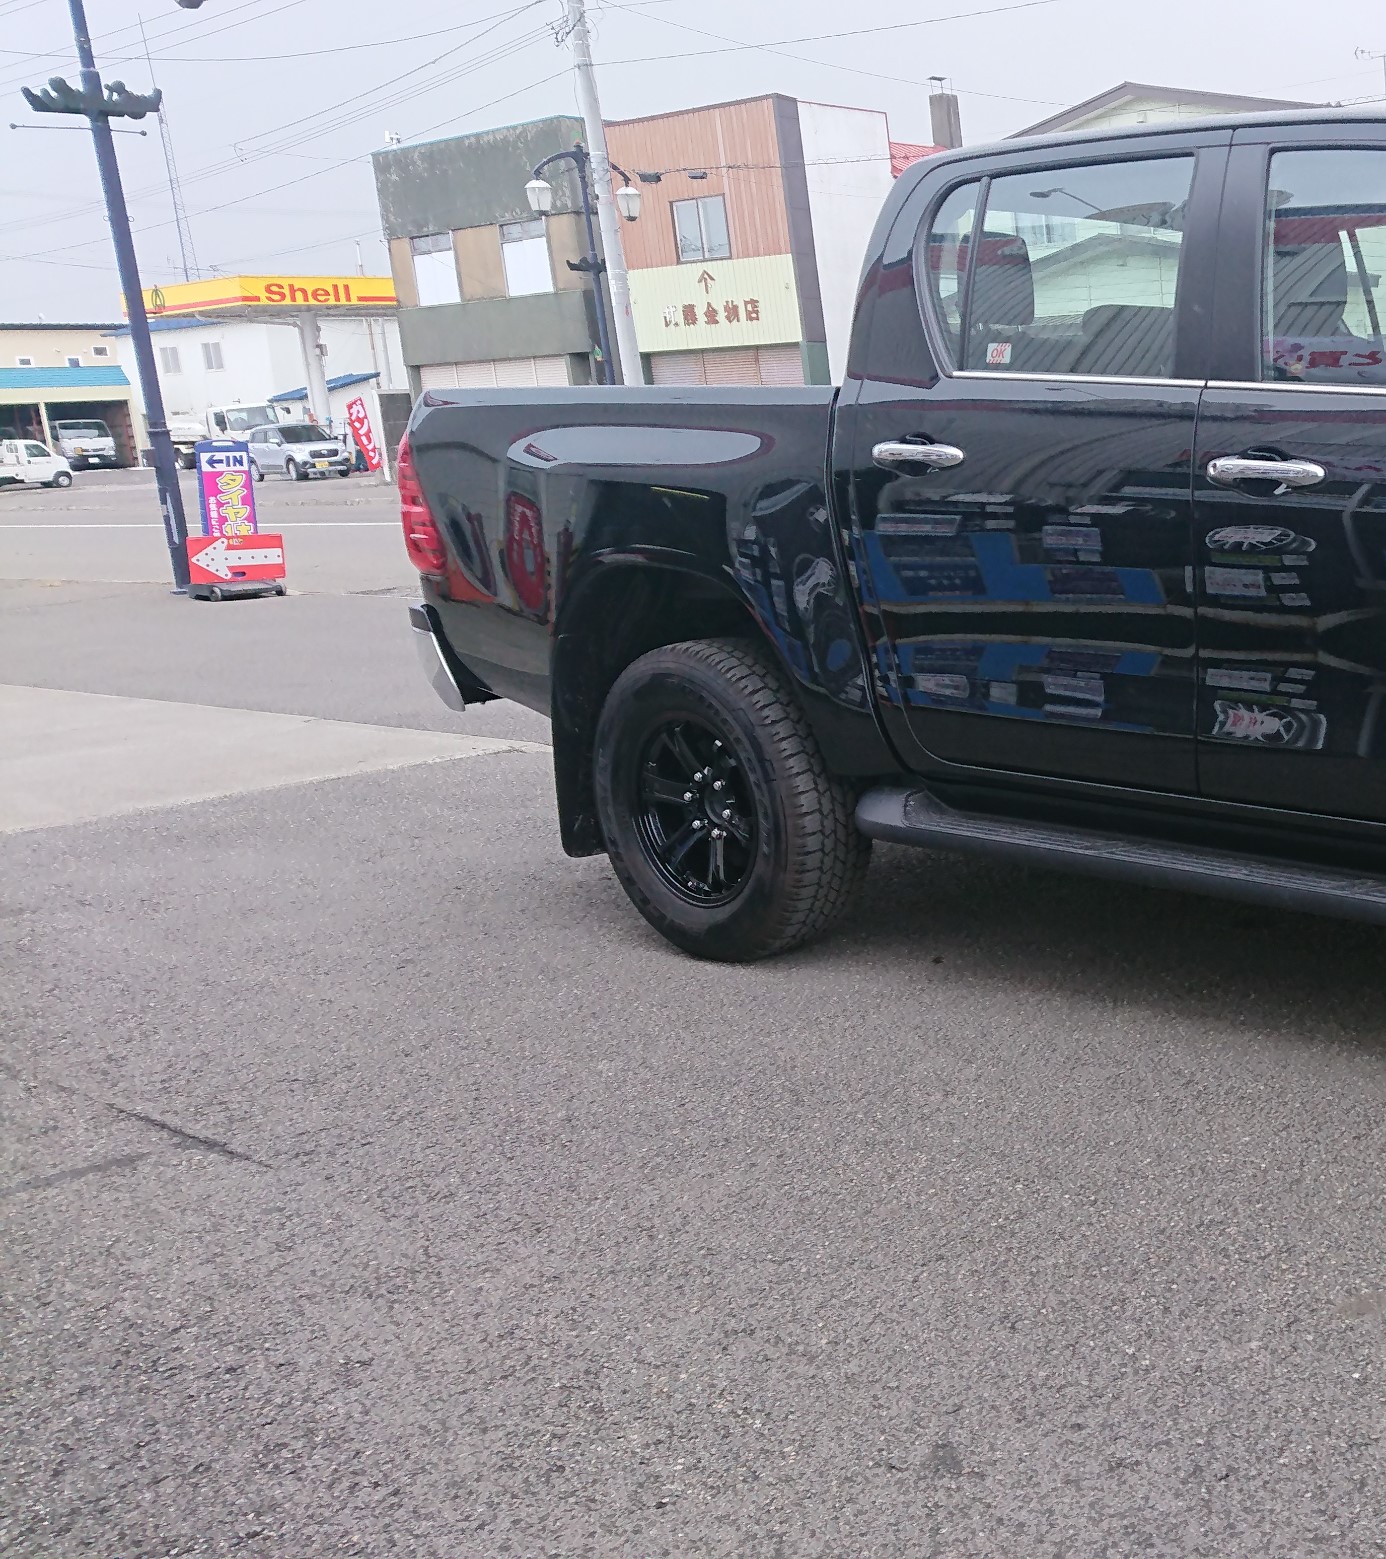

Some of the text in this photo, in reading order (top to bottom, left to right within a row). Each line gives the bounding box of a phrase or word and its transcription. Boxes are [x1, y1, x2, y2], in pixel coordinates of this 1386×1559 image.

[264, 283, 351, 303] Shell
[991, 348, 1007, 359] OK
[350, 400, 380, 465] ガソリン
[225, 454, 244, 468] IN
